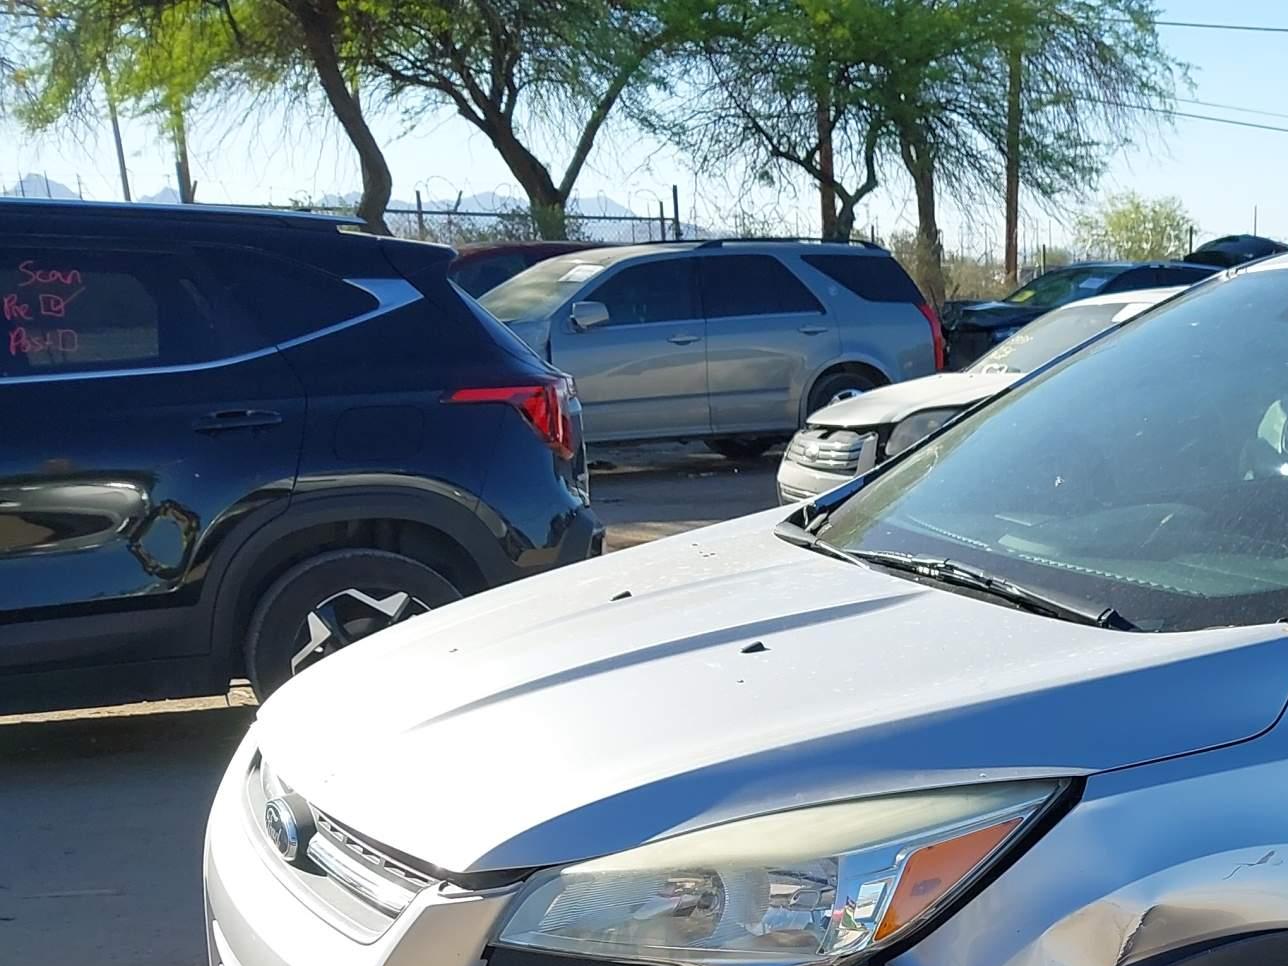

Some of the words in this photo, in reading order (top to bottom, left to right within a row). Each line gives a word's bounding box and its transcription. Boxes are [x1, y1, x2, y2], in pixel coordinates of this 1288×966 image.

[17, 260, 82, 286] Scan
[3, 293, 33, 320] Pre
[9, 327, 53, 356] Post
